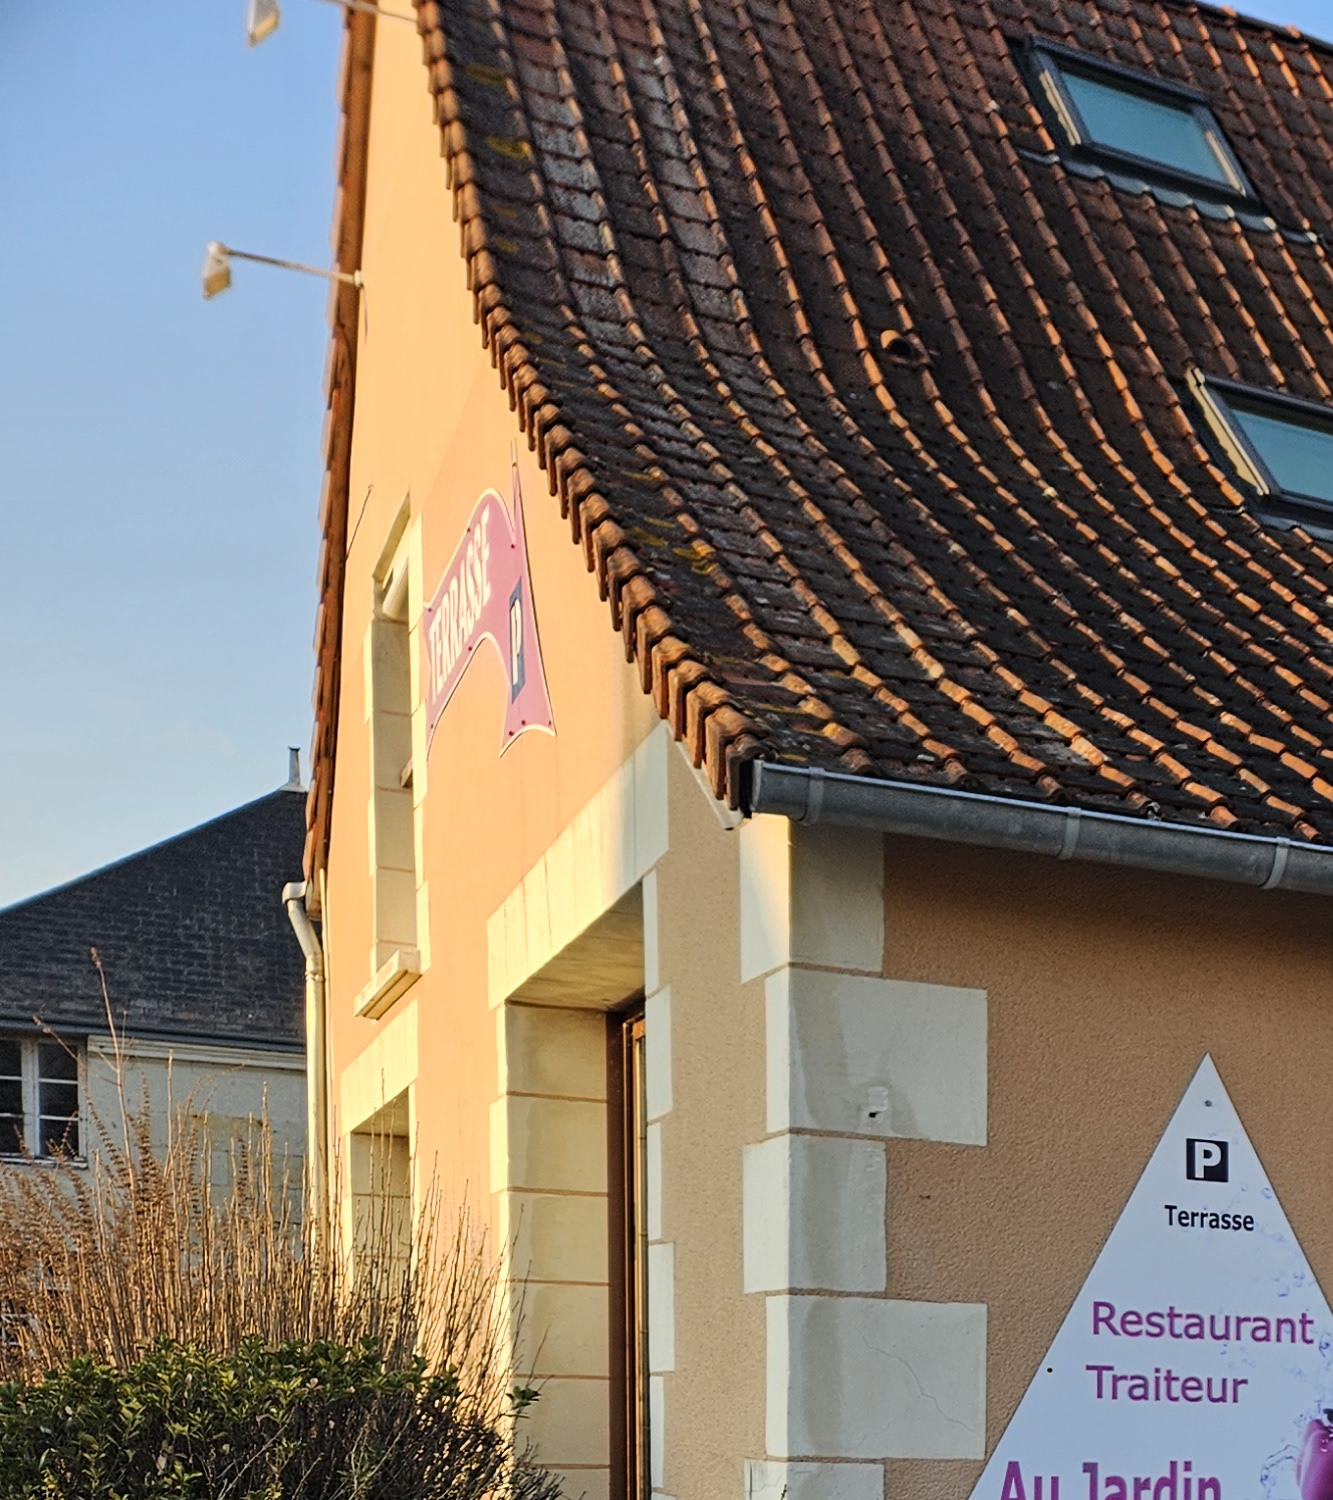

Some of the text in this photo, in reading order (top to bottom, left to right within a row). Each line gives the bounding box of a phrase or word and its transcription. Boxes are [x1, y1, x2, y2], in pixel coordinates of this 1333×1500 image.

[429, 504, 491, 704] TERRASSE
[1194, 1140, 1222, 1179] P
[1164, 1204, 1254, 1231] Terrasse
[1090, 1301, 1315, 1344] Restaurant
[1085, 1364, 1249, 1404] Traiteur
